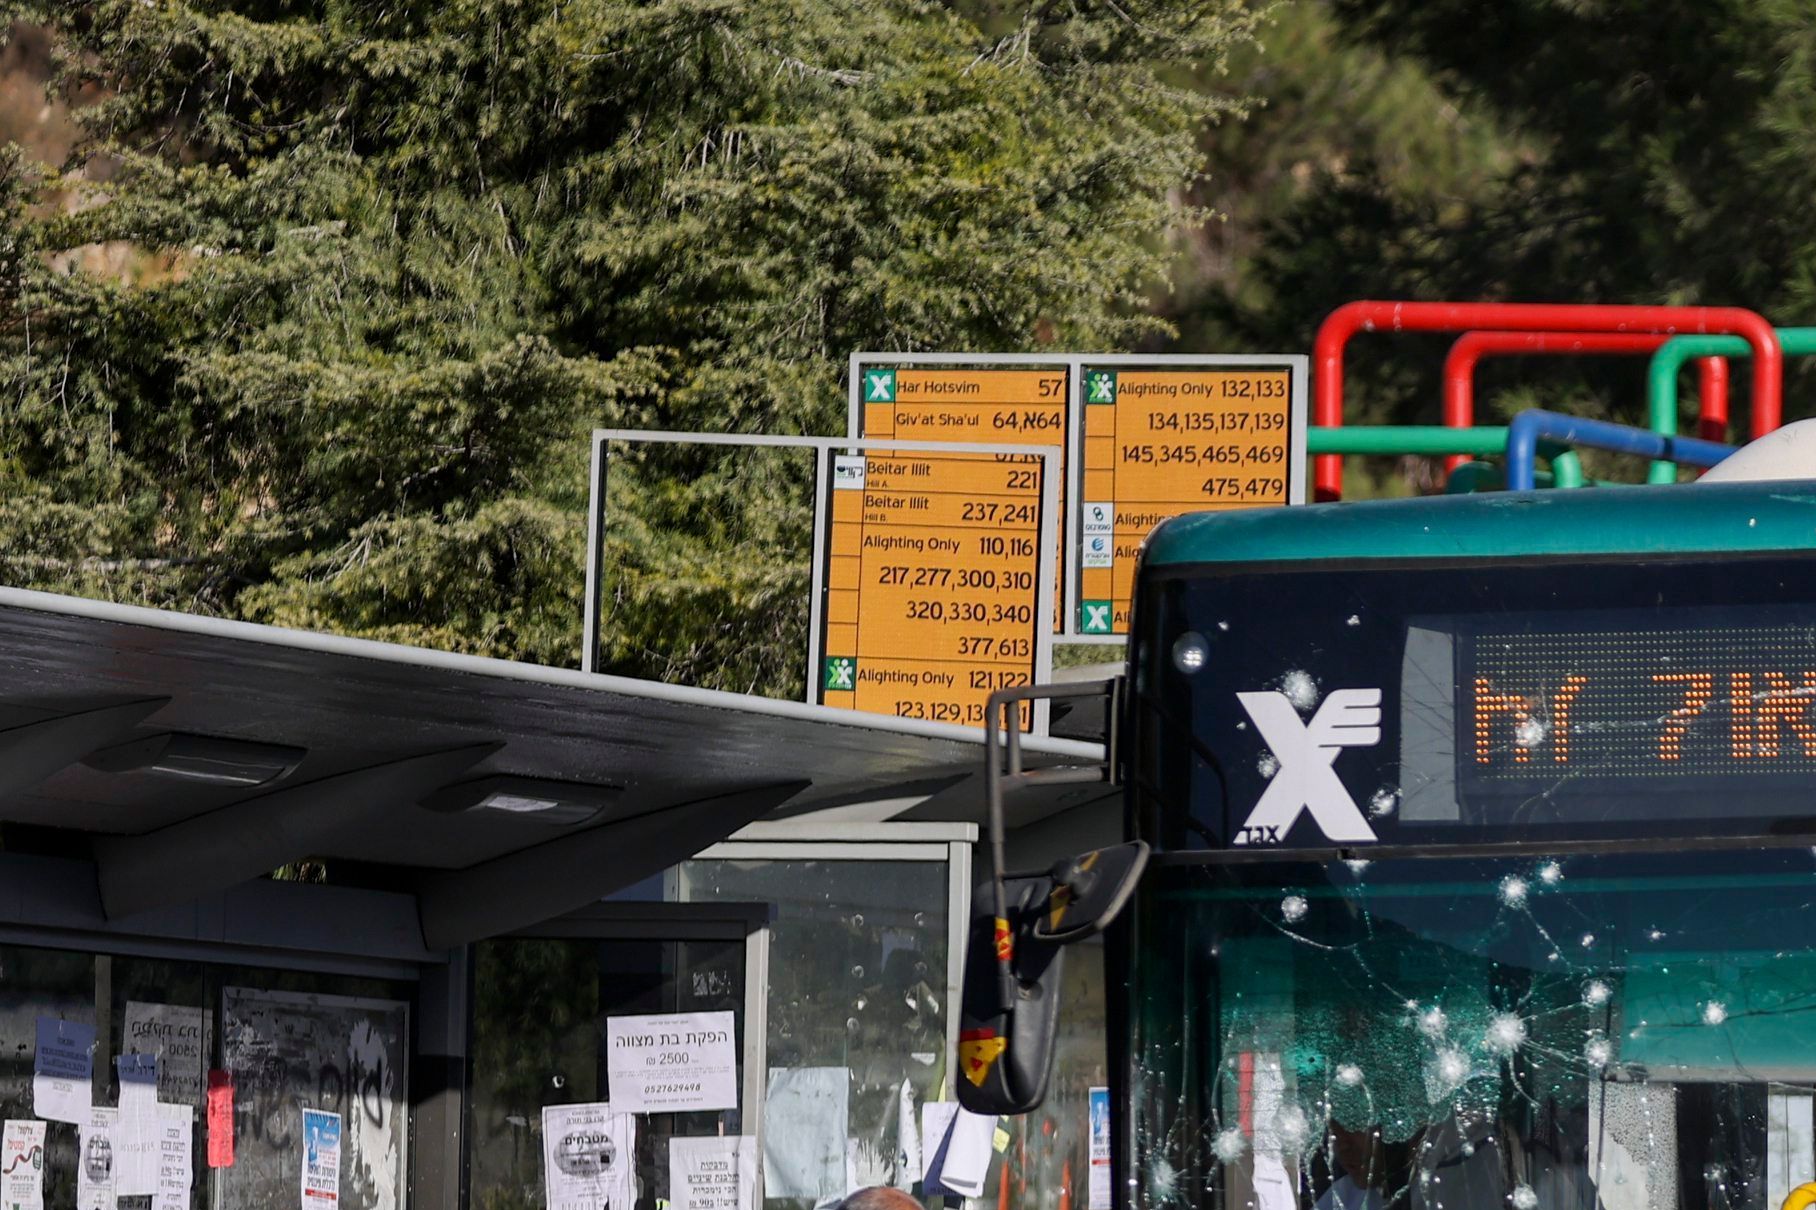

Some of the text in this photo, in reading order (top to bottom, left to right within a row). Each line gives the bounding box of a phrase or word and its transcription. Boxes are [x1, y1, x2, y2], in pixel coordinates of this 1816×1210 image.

[896, 380, 980, 394] Har Hotsvim
[1038, 379, 1062, 397] 57
[1118, 382, 1214, 398] Alighting Only
[1221, 380, 1285, 401] 132,133
[896, 414, 980, 426] Giv'at Sha'ul
[1148, 412, 1285, 434] 134,135,137,139
[1122, 446, 1284, 468] 145,345,465,469
[867, 461, 907, 476] Beitar
[911, 463, 931, 477] Illit
[1006, 471, 1037, 490] 221
[1202, 478, 1284, 500] 475,479
[866, 494, 929, 510] Beitar Illit
[961, 502, 1036, 526] 237,241
[864, 534, 960, 554] Alighting Only
[980, 536, 1034, 560] 110,116
[879, 566, 1033, 594] 217,277,300,310
[906, 601, 1032, 626] 320,330,340
[958, 637, 1030, 660] 377,613
[858, 669, 918, 686] Alighting
[922, 671, 954, 688] Only
[969, 670, 1028, 692] 121,122
[616, 1031, 728, 1048] הפקת בת מצווה
[660, 1052, 689, 1065] 2500
